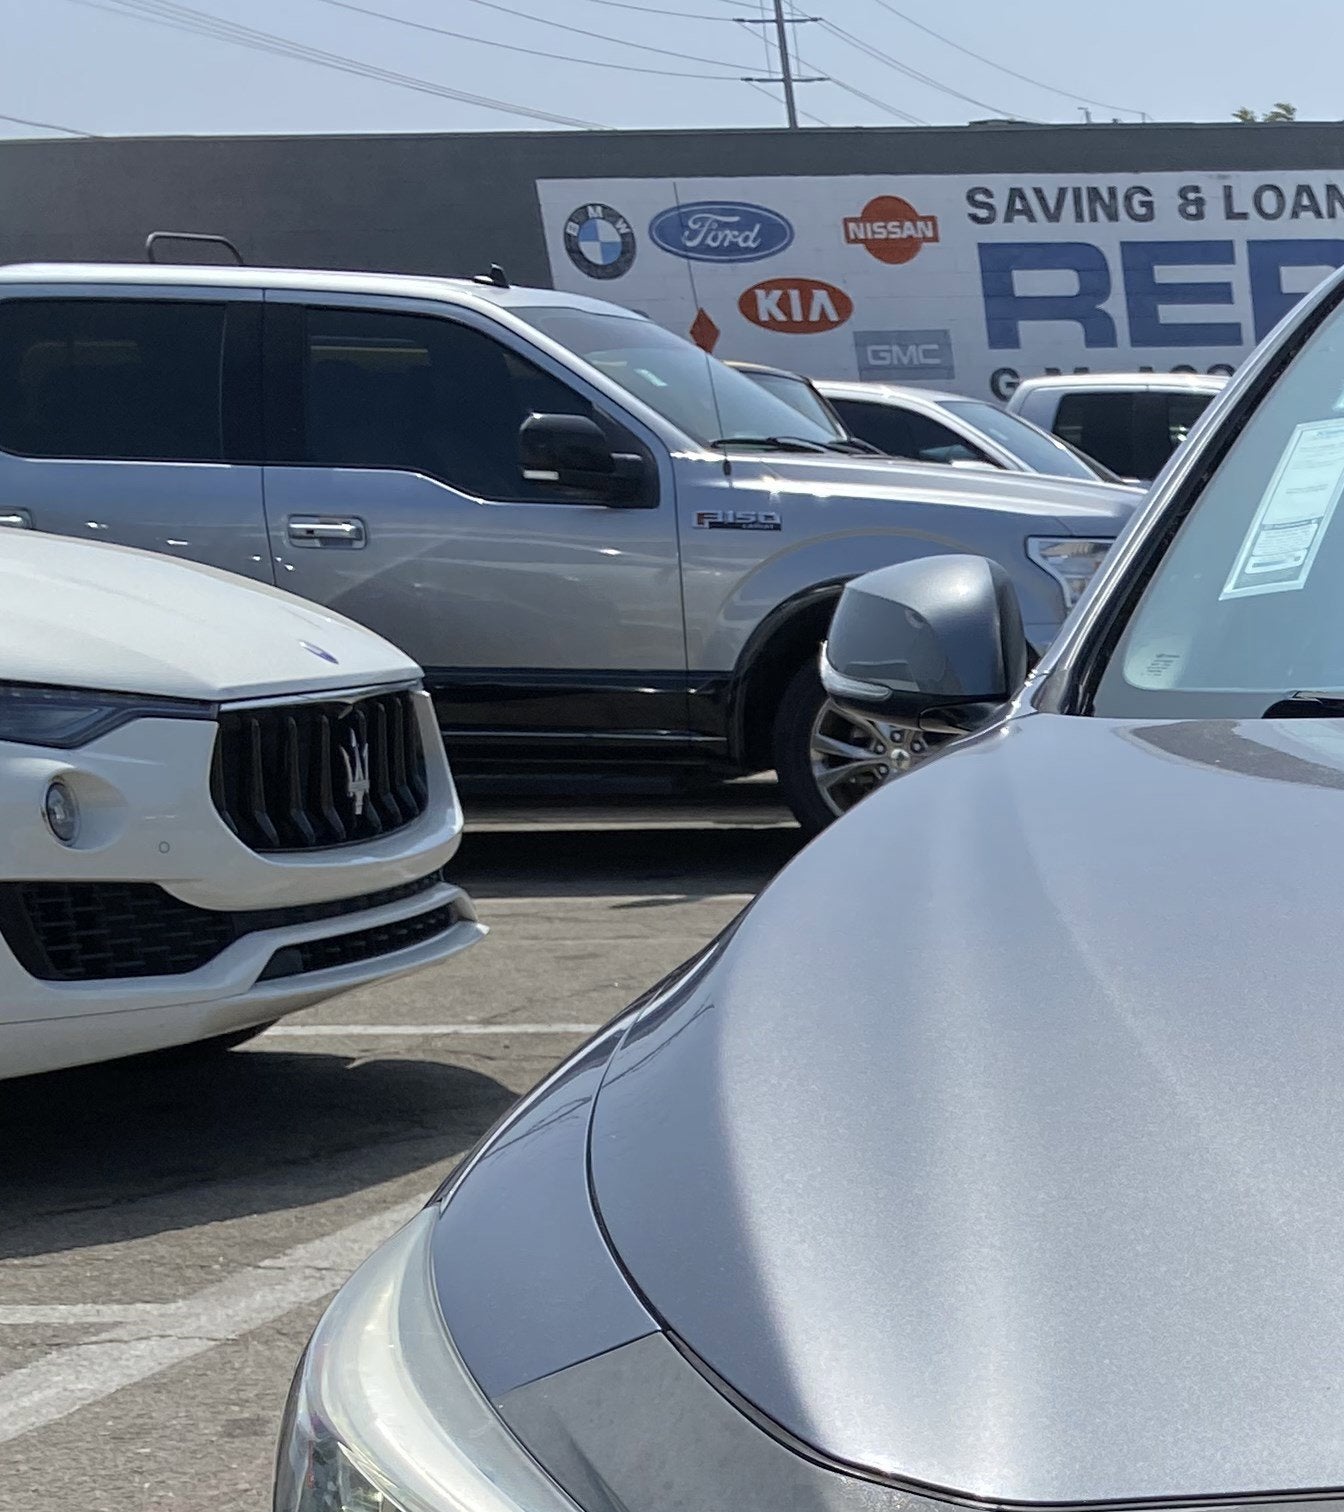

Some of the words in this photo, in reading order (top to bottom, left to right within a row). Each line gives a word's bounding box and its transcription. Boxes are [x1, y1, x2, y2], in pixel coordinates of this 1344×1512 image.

[966, 185, 1155, 225] SAVING
[1178, 184, 1206, 221] &
[682, 213, 761, 250] Ford
[849, 220, 934, 240] NISSAN
[754, 288, 840, 322] KIA
[867, 344, 941, 366] GMC
